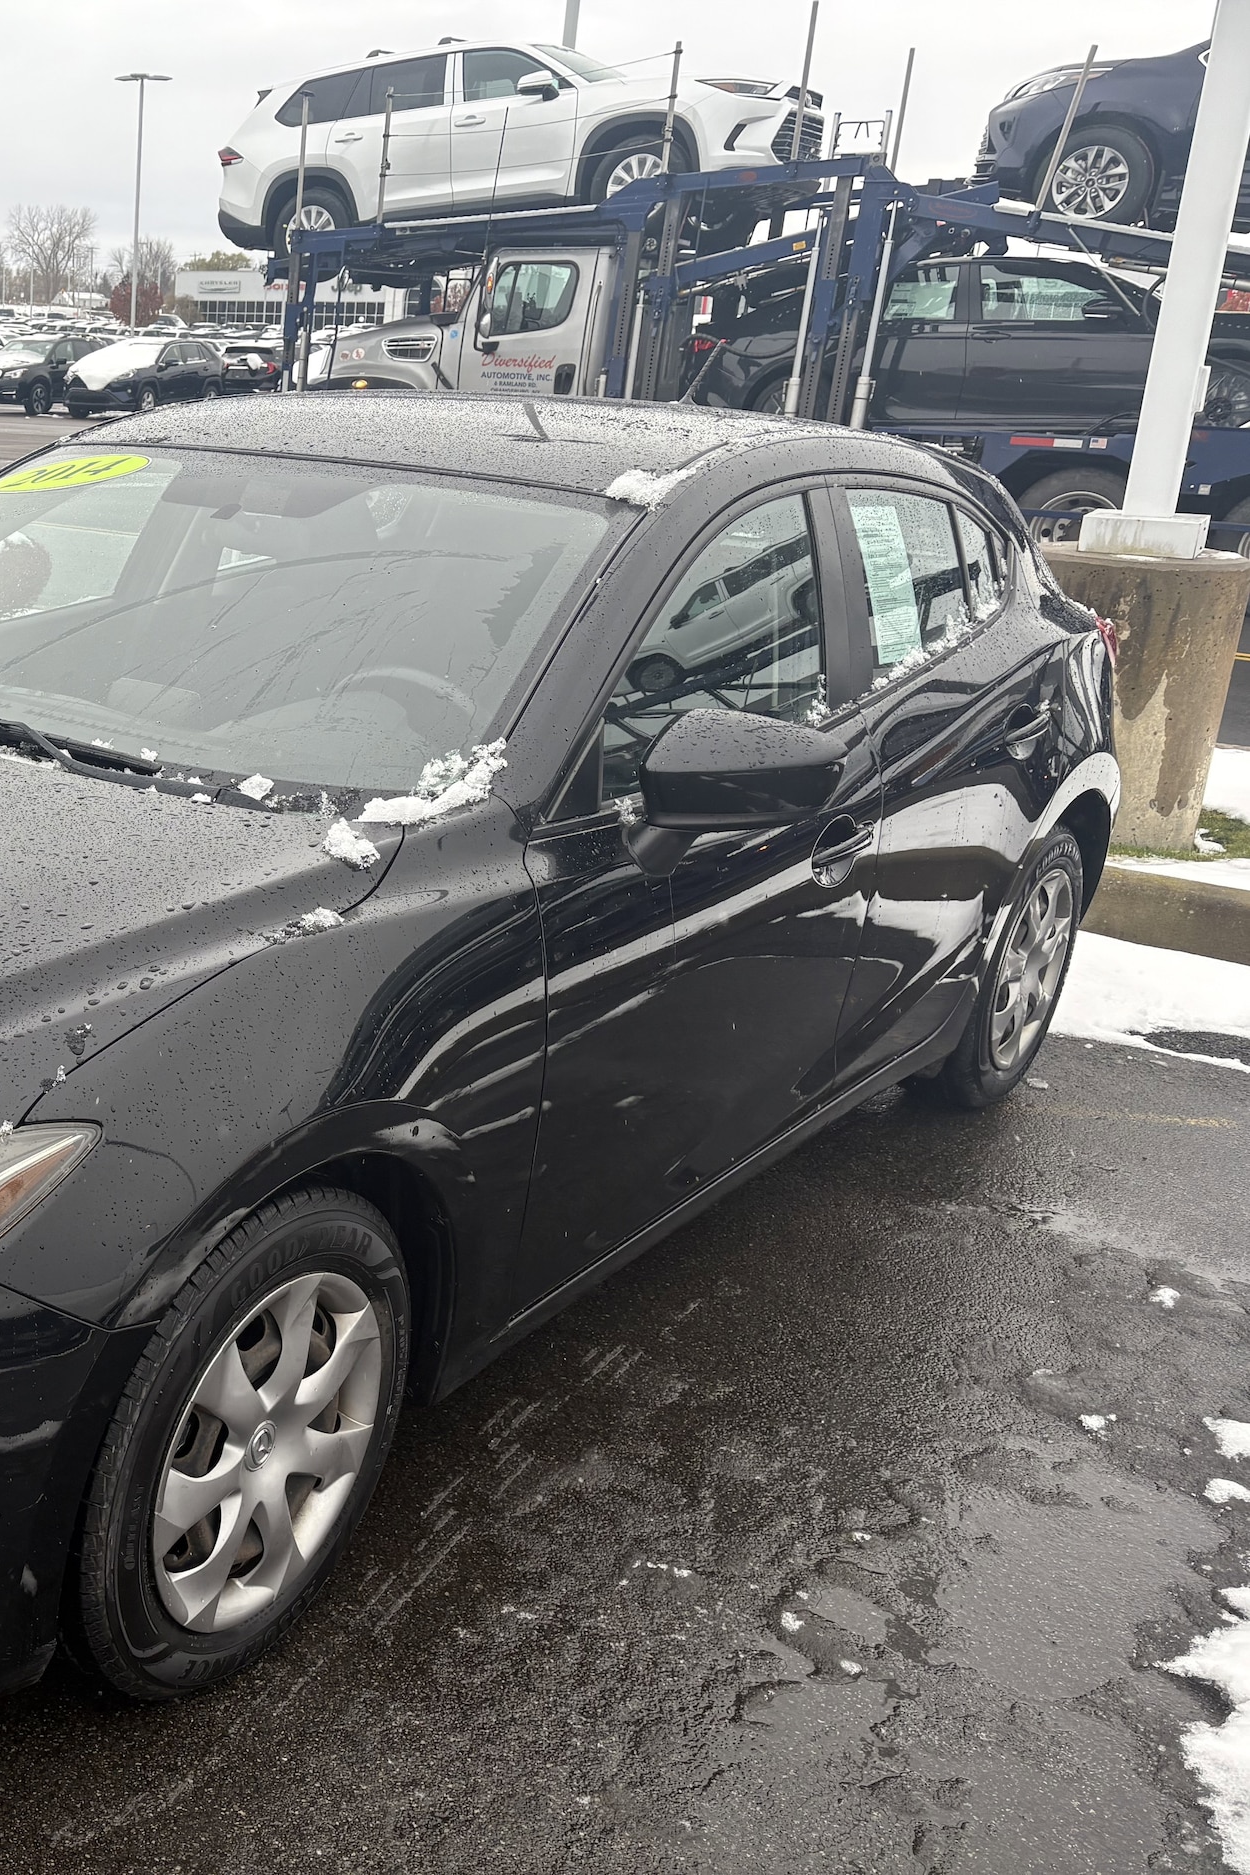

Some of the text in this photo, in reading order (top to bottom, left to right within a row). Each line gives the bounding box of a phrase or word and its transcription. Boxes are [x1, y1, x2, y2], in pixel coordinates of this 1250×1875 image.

[481, 351, 557, 373] Diversified
[480, 370, 553, 382] AUTOMOTIVE, INC.
[0, 457, 132, 489] 2014
